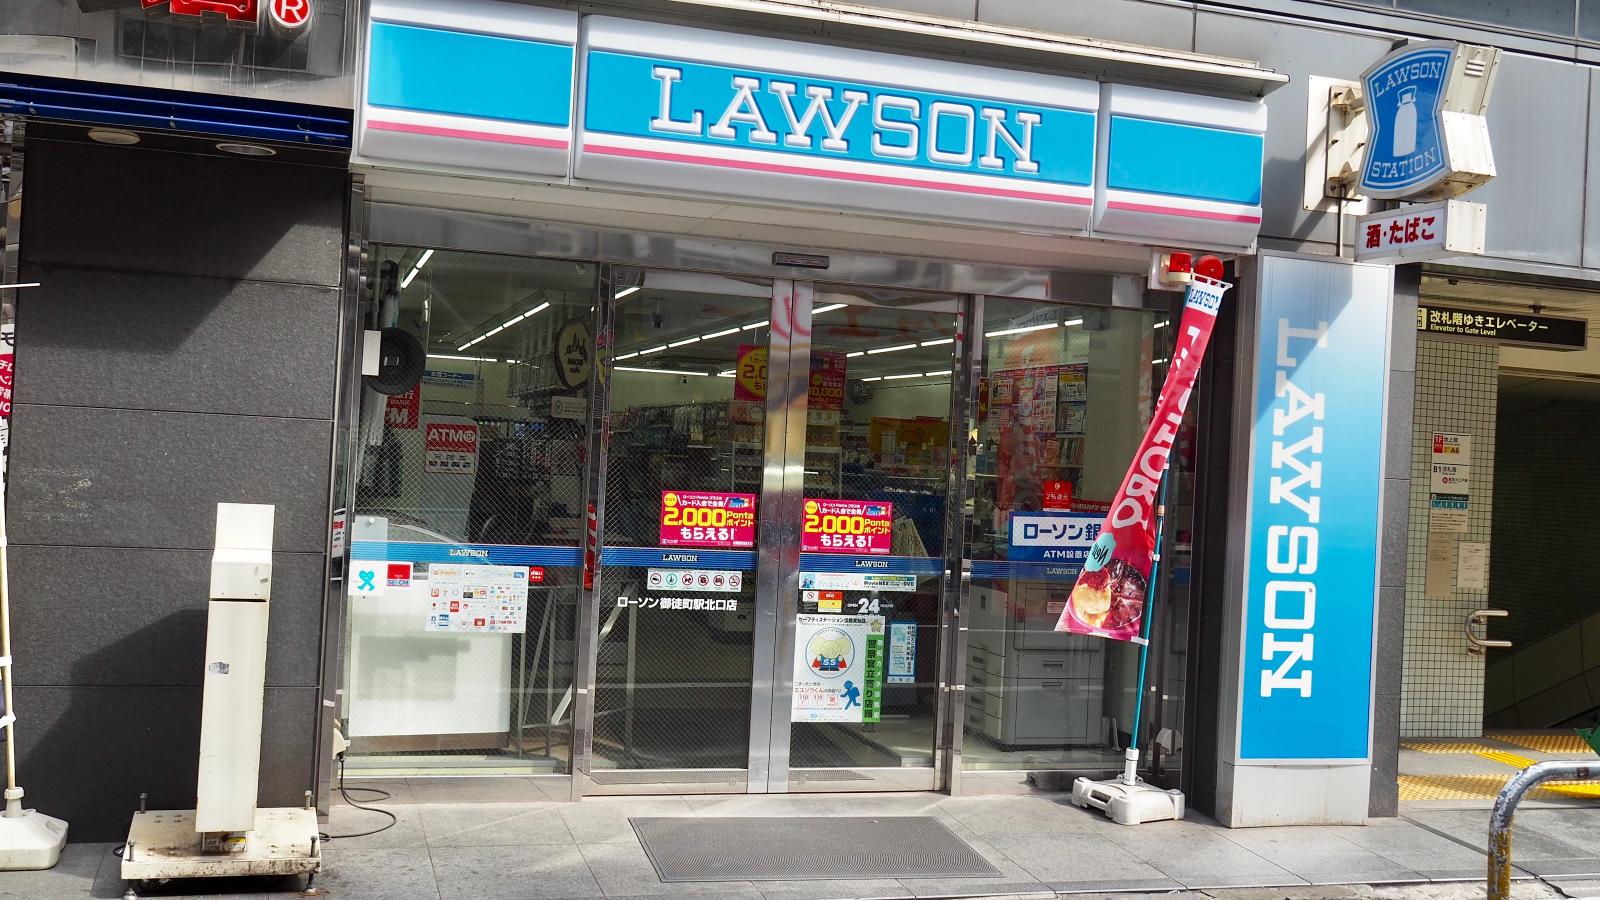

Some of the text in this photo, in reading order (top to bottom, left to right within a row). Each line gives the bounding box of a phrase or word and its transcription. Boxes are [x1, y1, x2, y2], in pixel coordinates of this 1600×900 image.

[1374, 61, 1442, 97] LAWSON
[649, 64, 1041, 174] LAWSON
[1371, 147, 1437, 178] STATION
[1366, 216, 1435, 248] 酒・たばこ
[1430, 310, 1548, 332] 改札階ゆきエレベーター
[1430, 324, 1455, 332] Elevator
[663, 506, 727, 526] 2,000
[726, 511, 754, 519] Ponta
[1260, 317, 1329, 698] LAWSON
[726, 519, 754, 527] ポイント
[804, 514, 864, 534] 2,000
[864, 518, 890, 527] Ponta
[864, 526, 890, 534] ポイント
[1024, 522, 1101, 541] ローソン銀
[450, 548, 489, 558] LAWSON
[617, 596, 738, 612] ローソン御徒町駅北口店
[858, 598, 880, 613] 24
